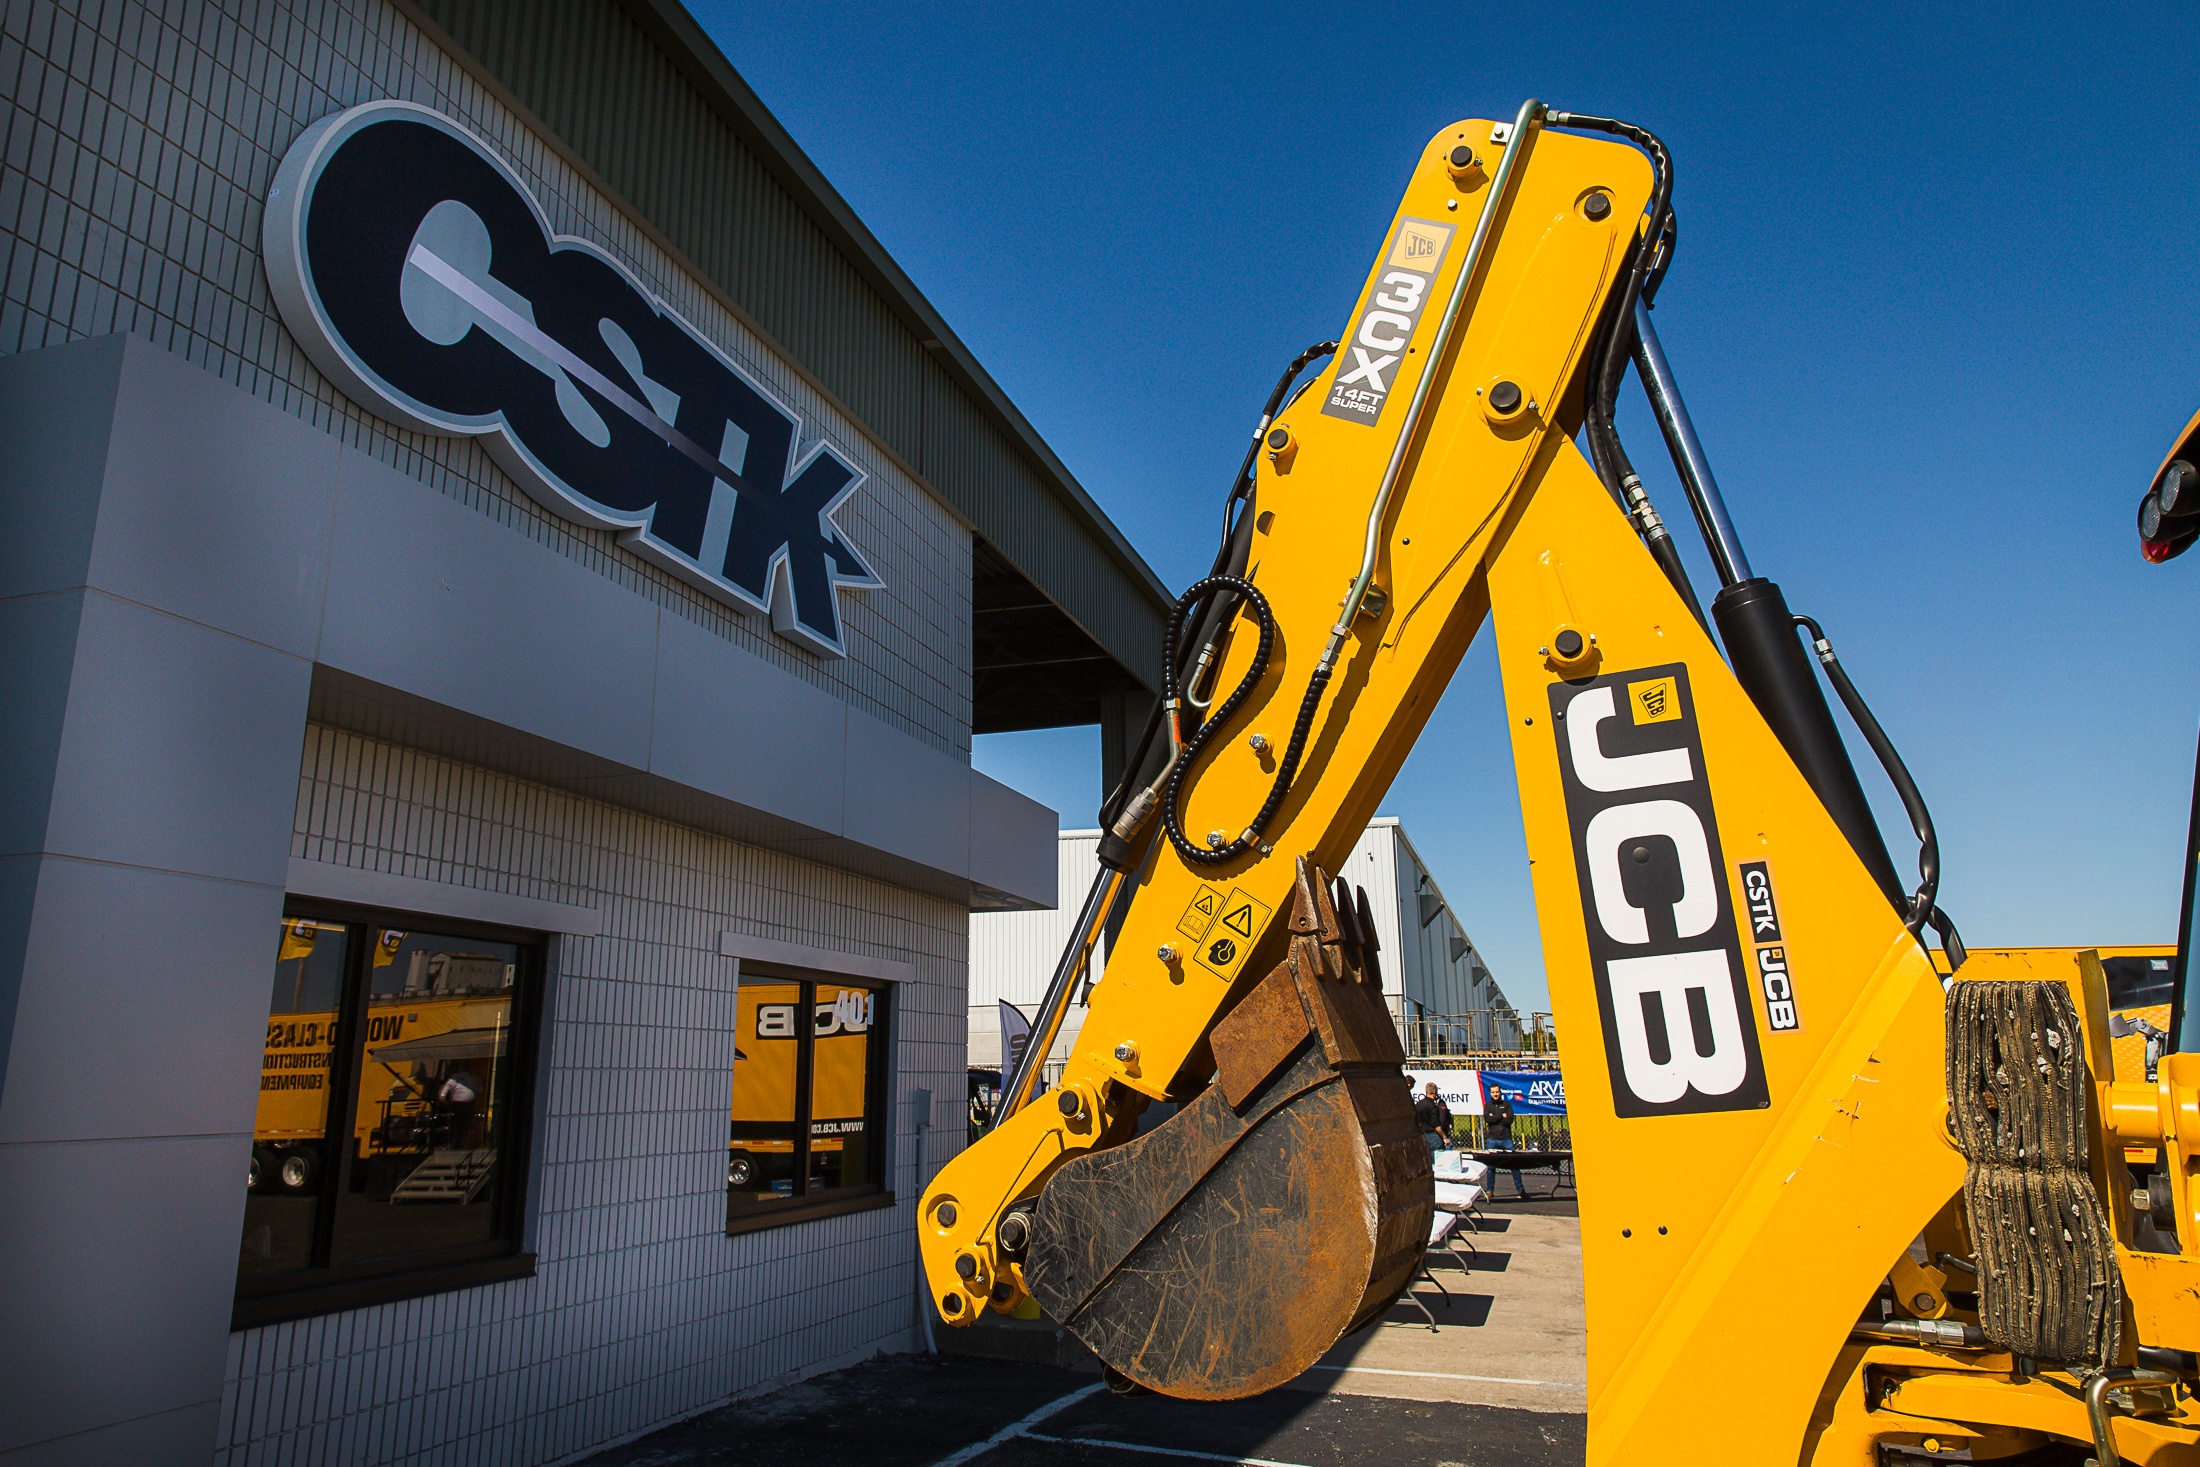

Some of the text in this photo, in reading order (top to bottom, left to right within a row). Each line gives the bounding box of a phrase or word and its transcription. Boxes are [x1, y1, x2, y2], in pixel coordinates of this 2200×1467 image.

[1407, 234, 1435, 257] JCB
[1337, 271, 1426, 393] 3CX
[304, 117, 872, 646] CSTK
[1330, 396, 1377, 415] SUPER
[1334, 385, 1384, 404] 14FT
[1642, 689, 1665, 716] JCB
[1566, 686, 1747, 1104] JCB
[1746, 870, 1776, 934] CSTK
[834, 990, 874, 1025] 401
[1759, 949, 1796, 1029] JCB
